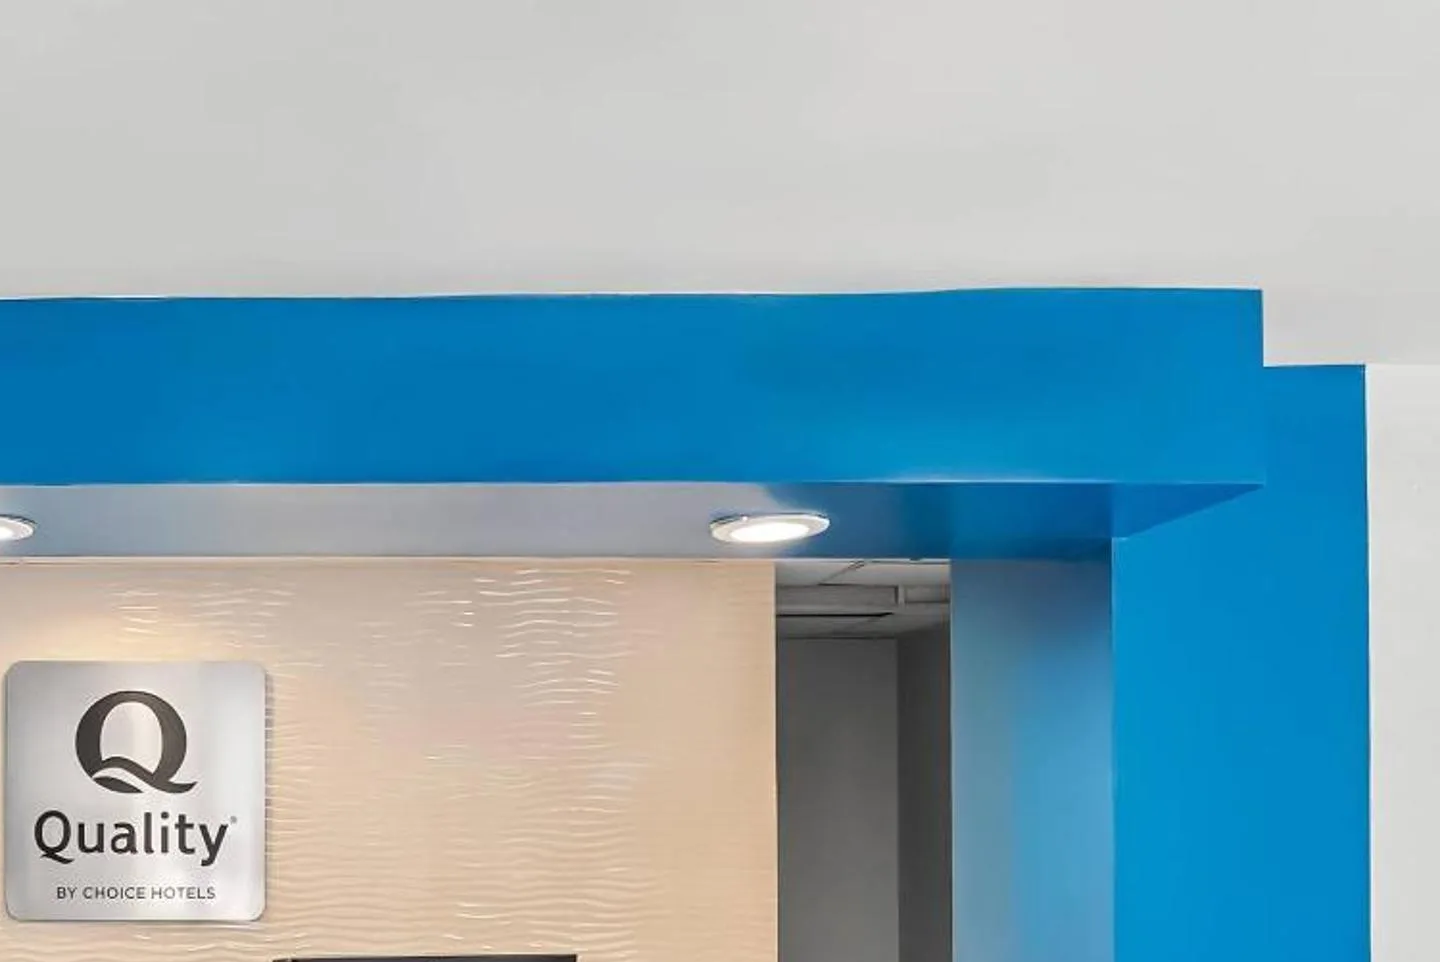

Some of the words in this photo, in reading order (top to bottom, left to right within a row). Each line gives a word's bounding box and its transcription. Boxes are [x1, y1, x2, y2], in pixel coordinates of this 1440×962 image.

[74, 690, 198, 794] Q
[33, 809, 229, 867] Quality
[56, 886, 77, 900] BY
[82, 886, 146, 900] CHOICE
[150, 886, 216, 900] HOTELS
